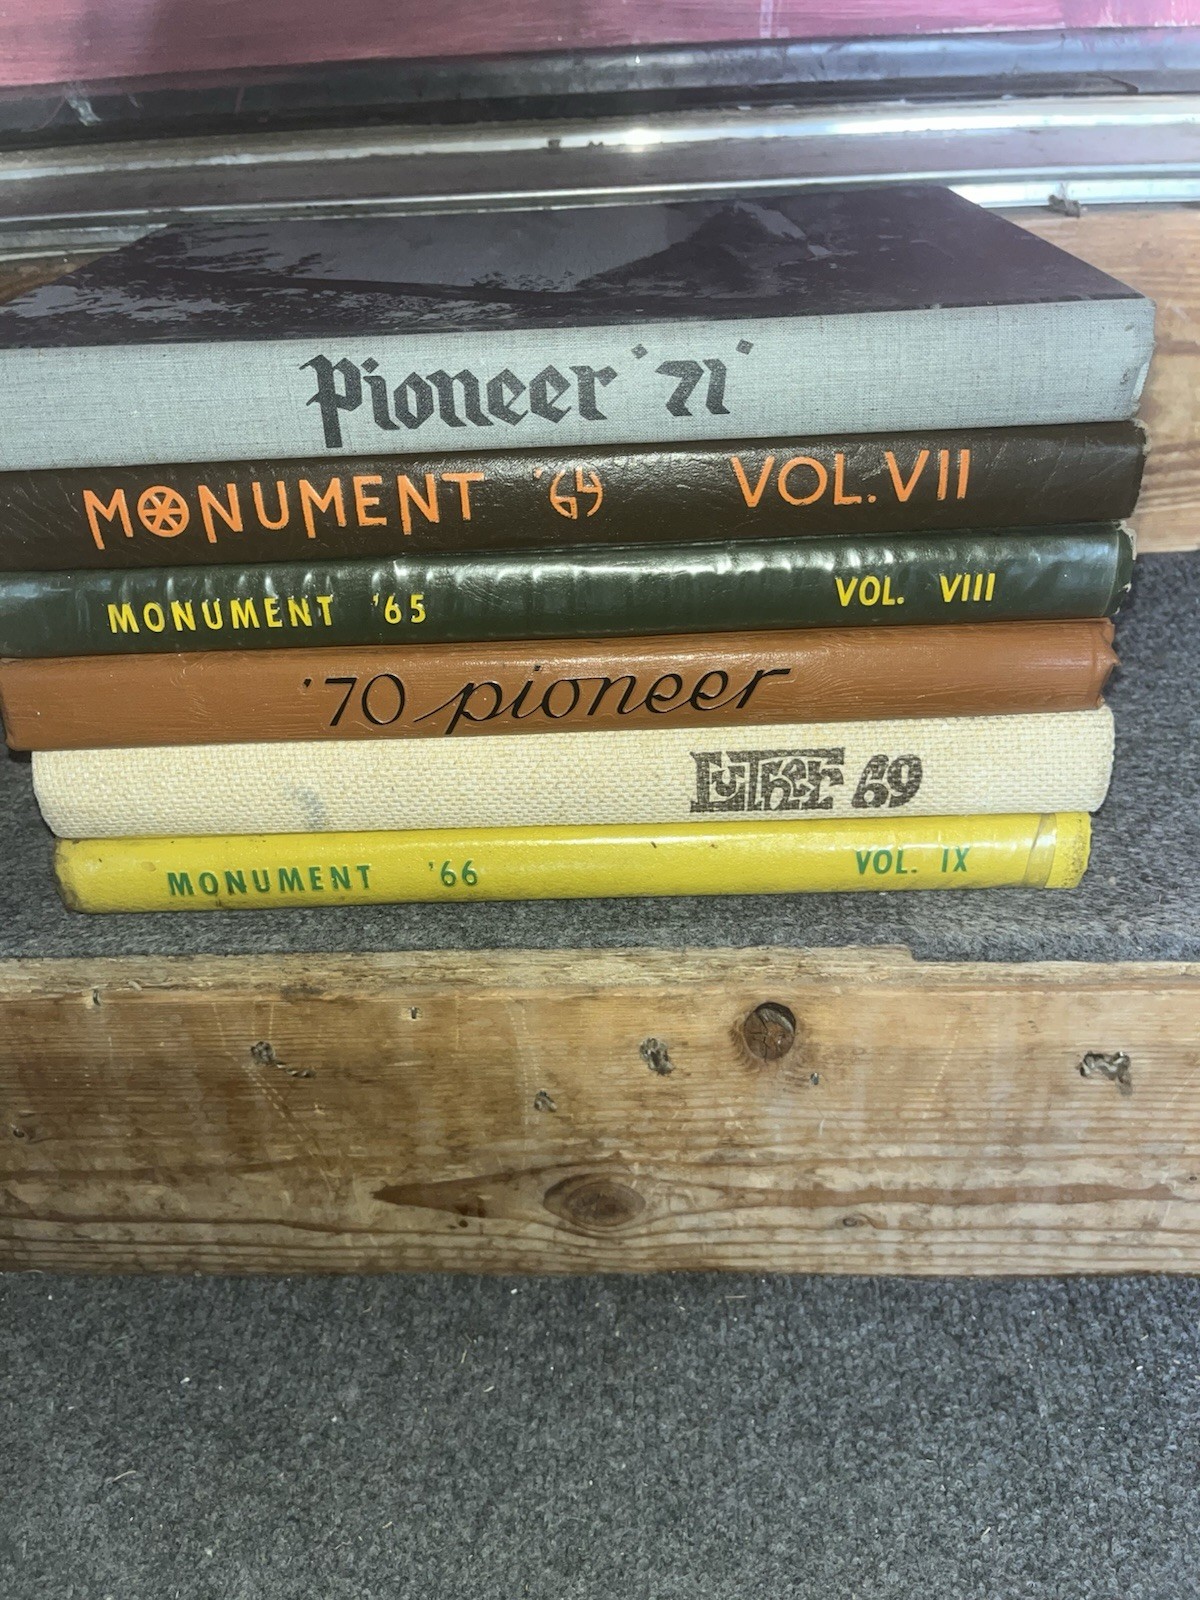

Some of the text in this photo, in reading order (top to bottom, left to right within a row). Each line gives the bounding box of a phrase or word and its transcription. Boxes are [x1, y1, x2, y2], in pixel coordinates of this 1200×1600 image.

[299, 354, 618, 448] Pioneer
[82, 472, 485, 550] MONUMENT
[107, 573, 996, 634] MONUMENT '65 VOL. VIII
[303, 664, 791, 735] '70 pioneer
[851, 754, 924, 808] 69
[167, 845, 970, 897] MONUMENT '66 VOL. IX
